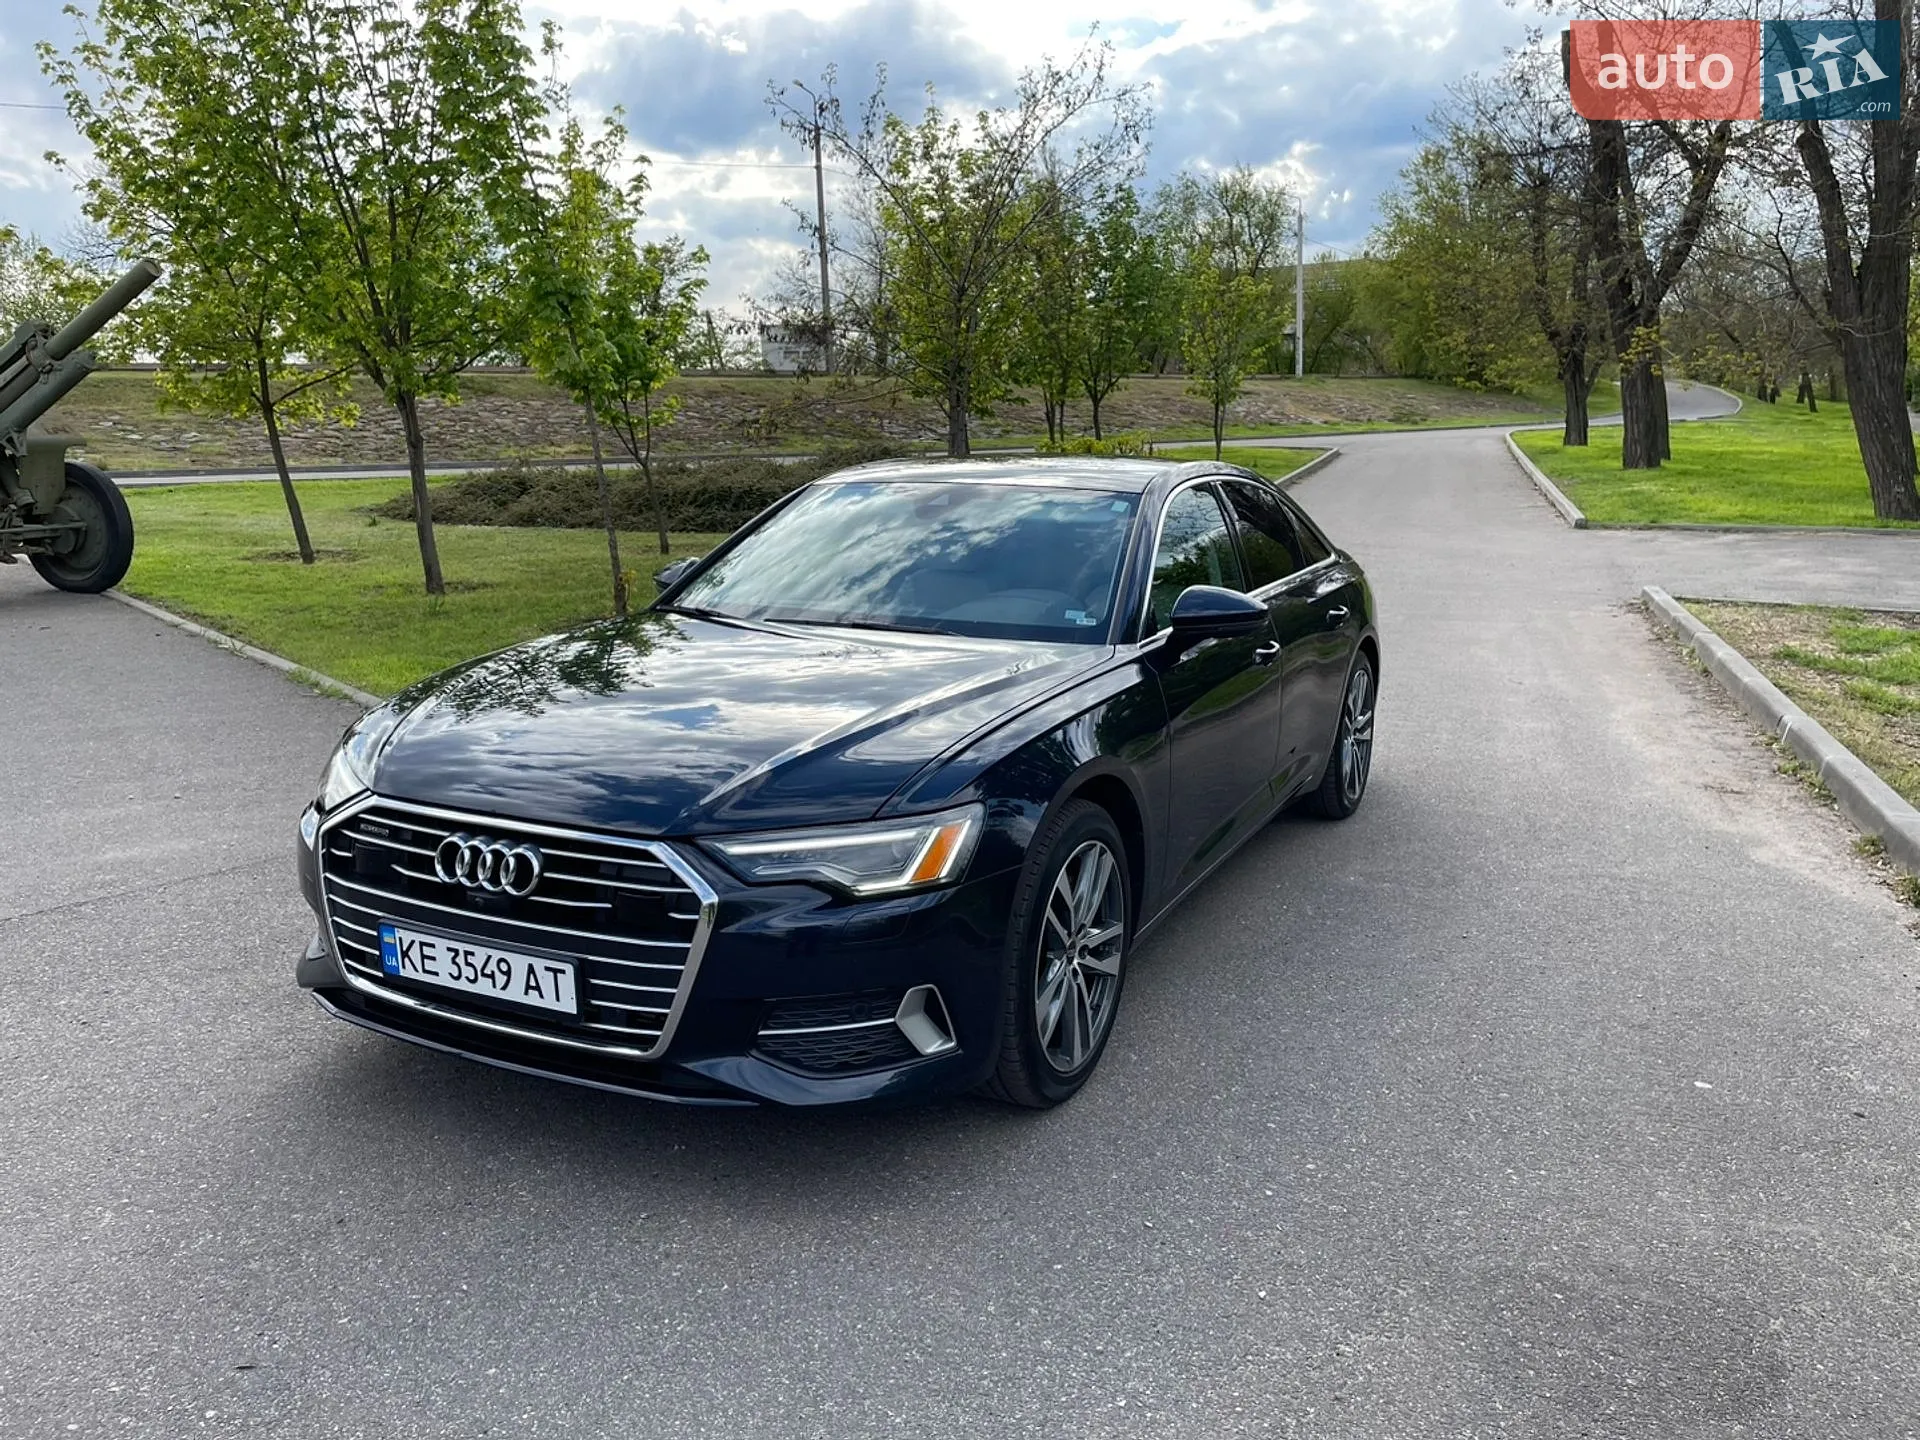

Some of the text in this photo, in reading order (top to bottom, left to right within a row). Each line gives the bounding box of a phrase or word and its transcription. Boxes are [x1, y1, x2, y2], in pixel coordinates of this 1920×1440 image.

[385, 955, 398, 967] UA
[399, 937, 566, 1002] KE 3549 AT
